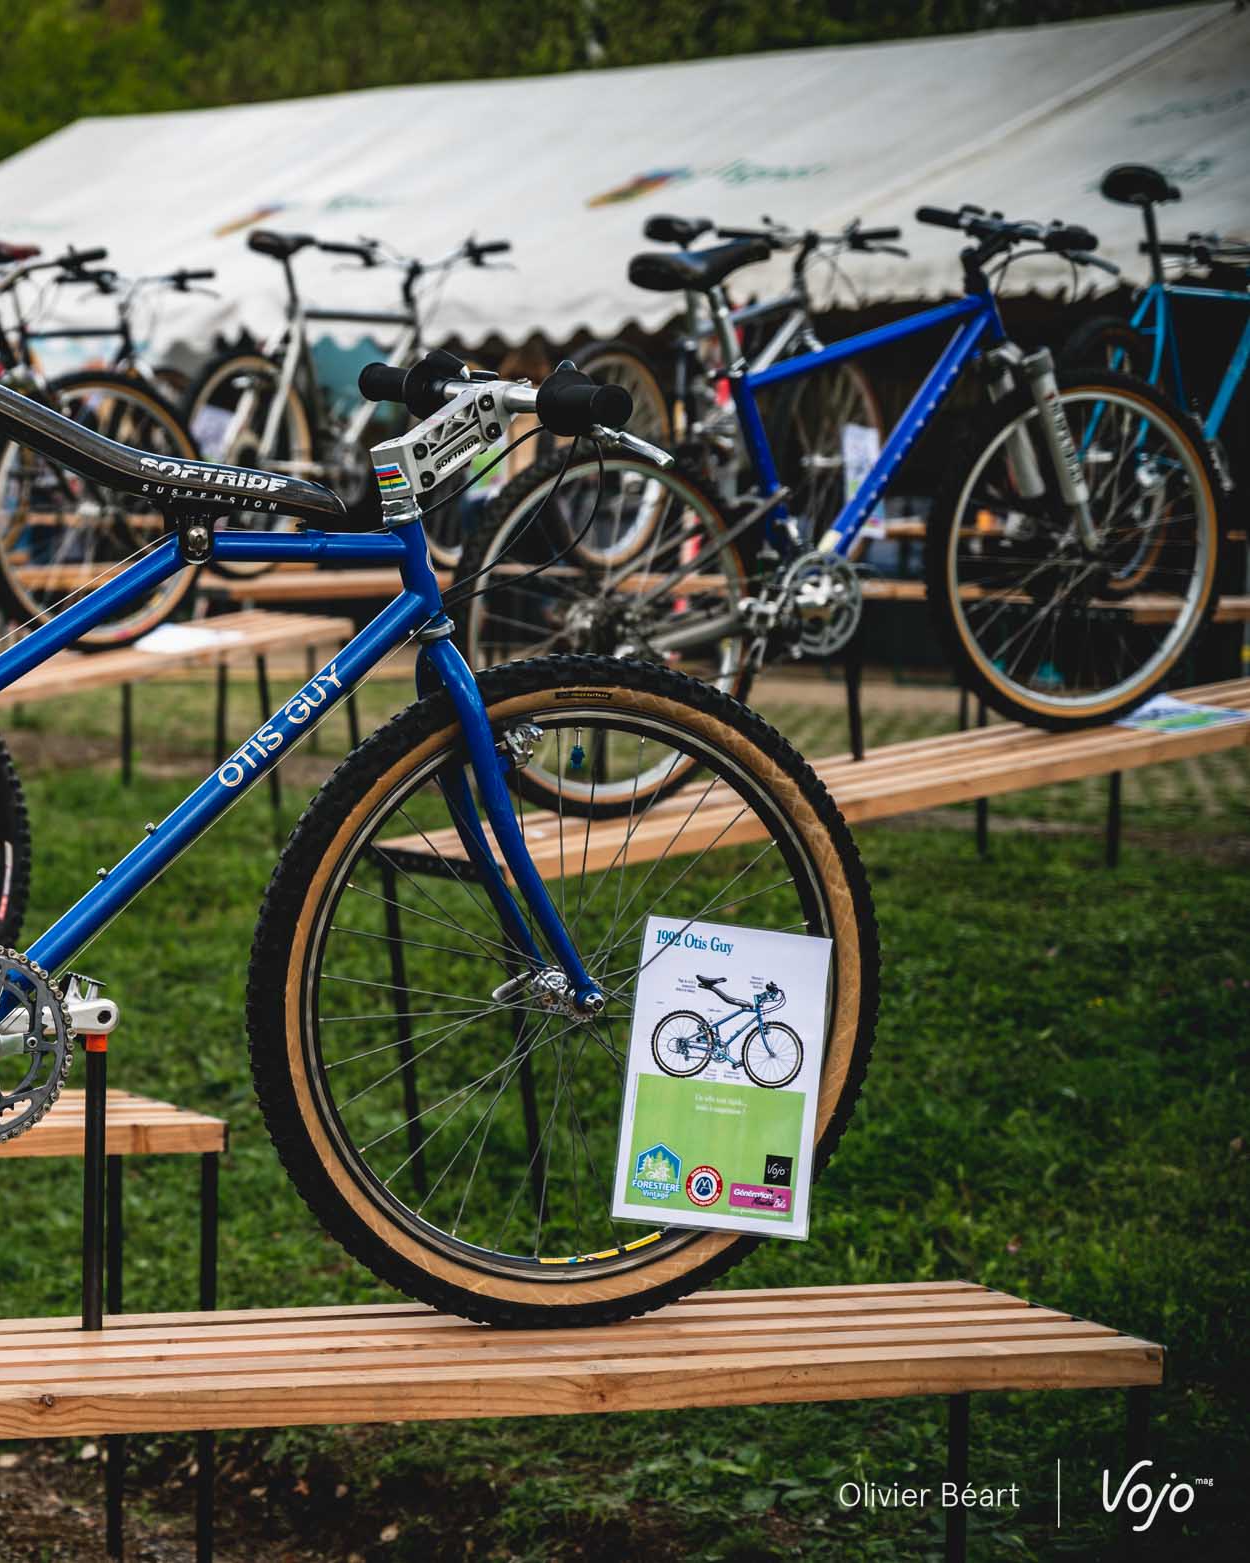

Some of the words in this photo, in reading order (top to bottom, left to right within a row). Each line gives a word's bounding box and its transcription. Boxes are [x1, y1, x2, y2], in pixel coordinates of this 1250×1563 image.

[435, 435, 481, 473] SOFTRIDE
[139, 456, 288, 493] SOFTRIDE
[141, 483, 279, 513] SUSPENSION
[217, 724, 284, 788] OTIS
[284, 662, 343, 725] GUY
[655, 928, 681, 947] 1992
[684, 932, 708, 950] Otis
[710, 936, 734, 956] Guy
[767, 1162, 786, 1179] Vojo
